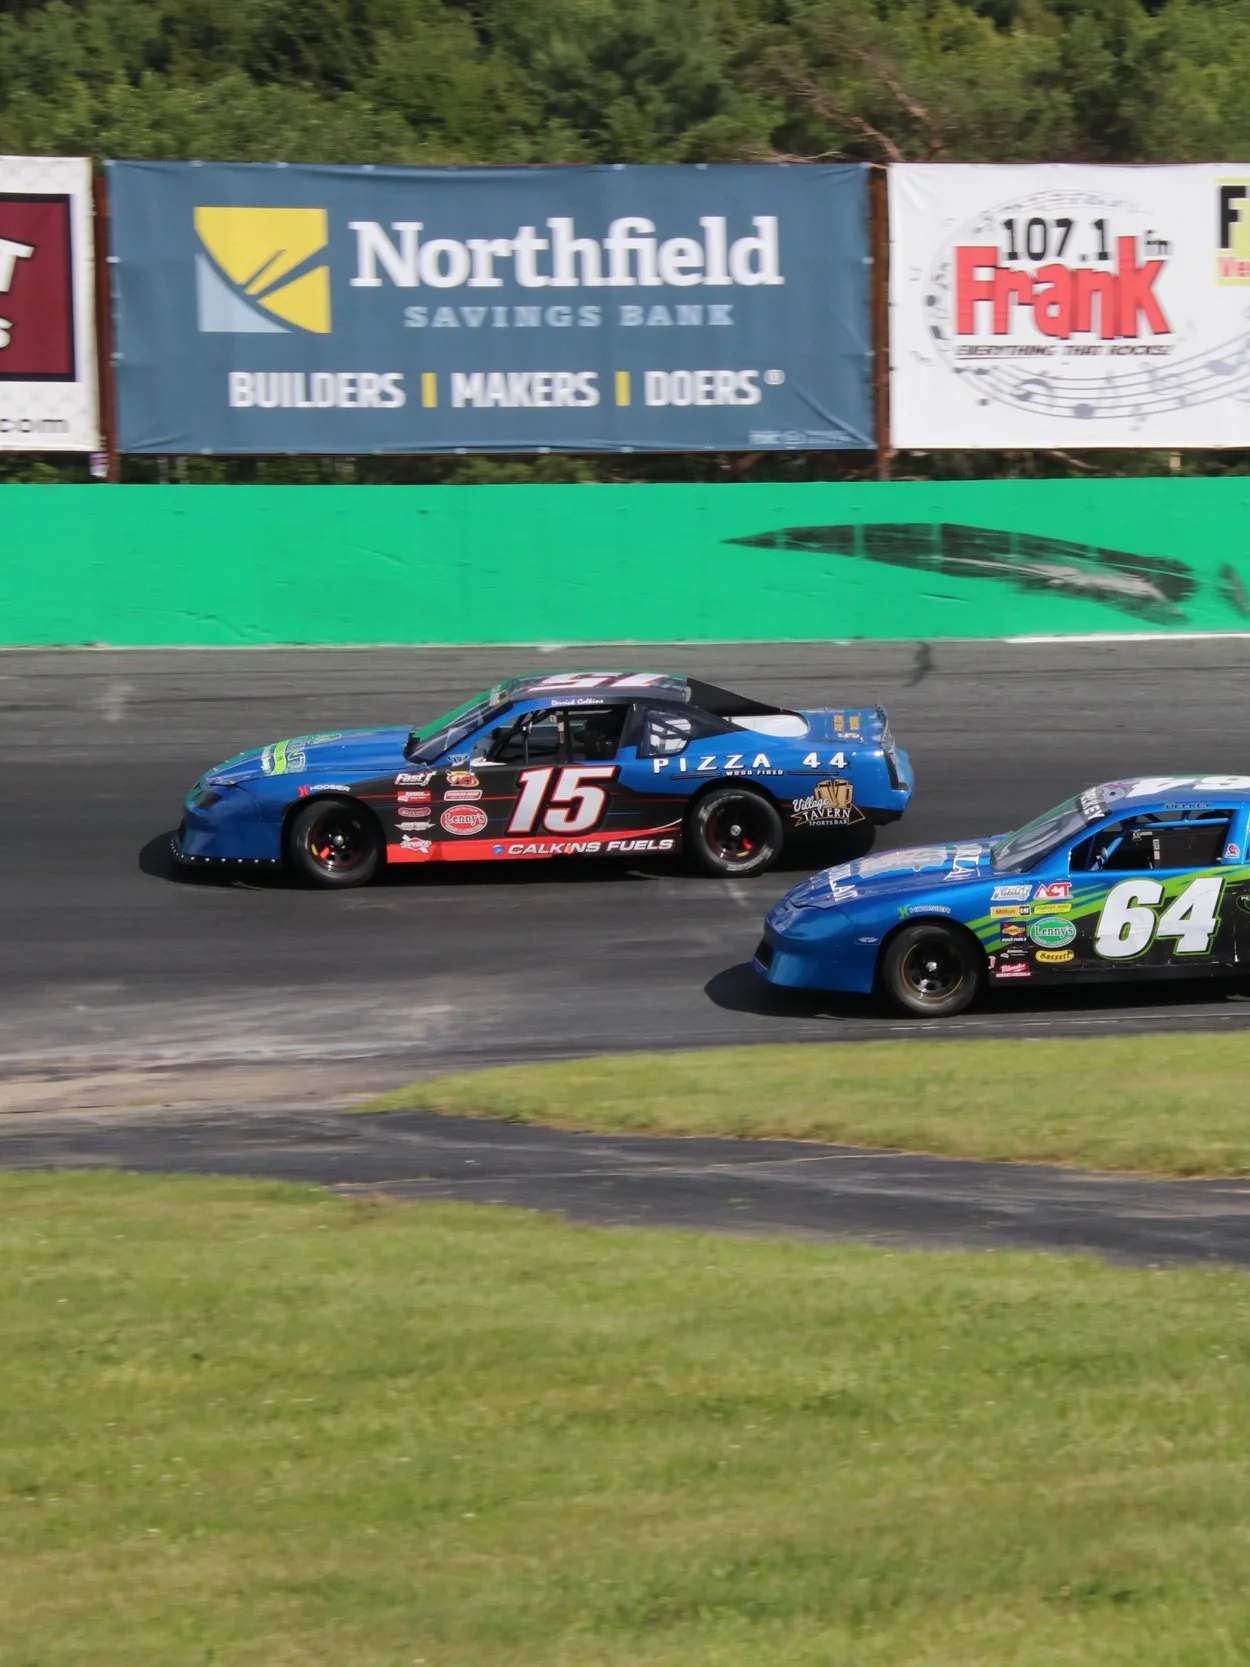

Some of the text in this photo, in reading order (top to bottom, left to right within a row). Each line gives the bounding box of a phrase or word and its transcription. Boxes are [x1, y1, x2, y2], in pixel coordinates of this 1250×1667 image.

[1002, 217, 1111, 262] 107.1
[348, 216, 785, 288] Northfield
[955, 235, 1172, 340] Frank
[404, 304, 734, 328] SAVINGS BANK
[955, 344, 1055, 357] EVERYTHING
[1061, 344, 1099, 356] THAT
[228, 371, 406, 408] BUILDERS
[452, 371, 600, 408] MAKERS
[653, 753, 772, 774] PIZZA
[309, 784, 350, 792] HOOSIER
[507, 765, 618, 834] 15
[792, 795, 829, 812] Village
[445, 813, 485, 826] Lenny's
[803, 808, 851, 821] TAVERN
[508, 839, 674, 855] CALKINS FUELS
[1034, 882, 1072, 899] ACT
[1094, 877, 1224, 960] 64
[1034, 925, 1074, 938] Lenny's
